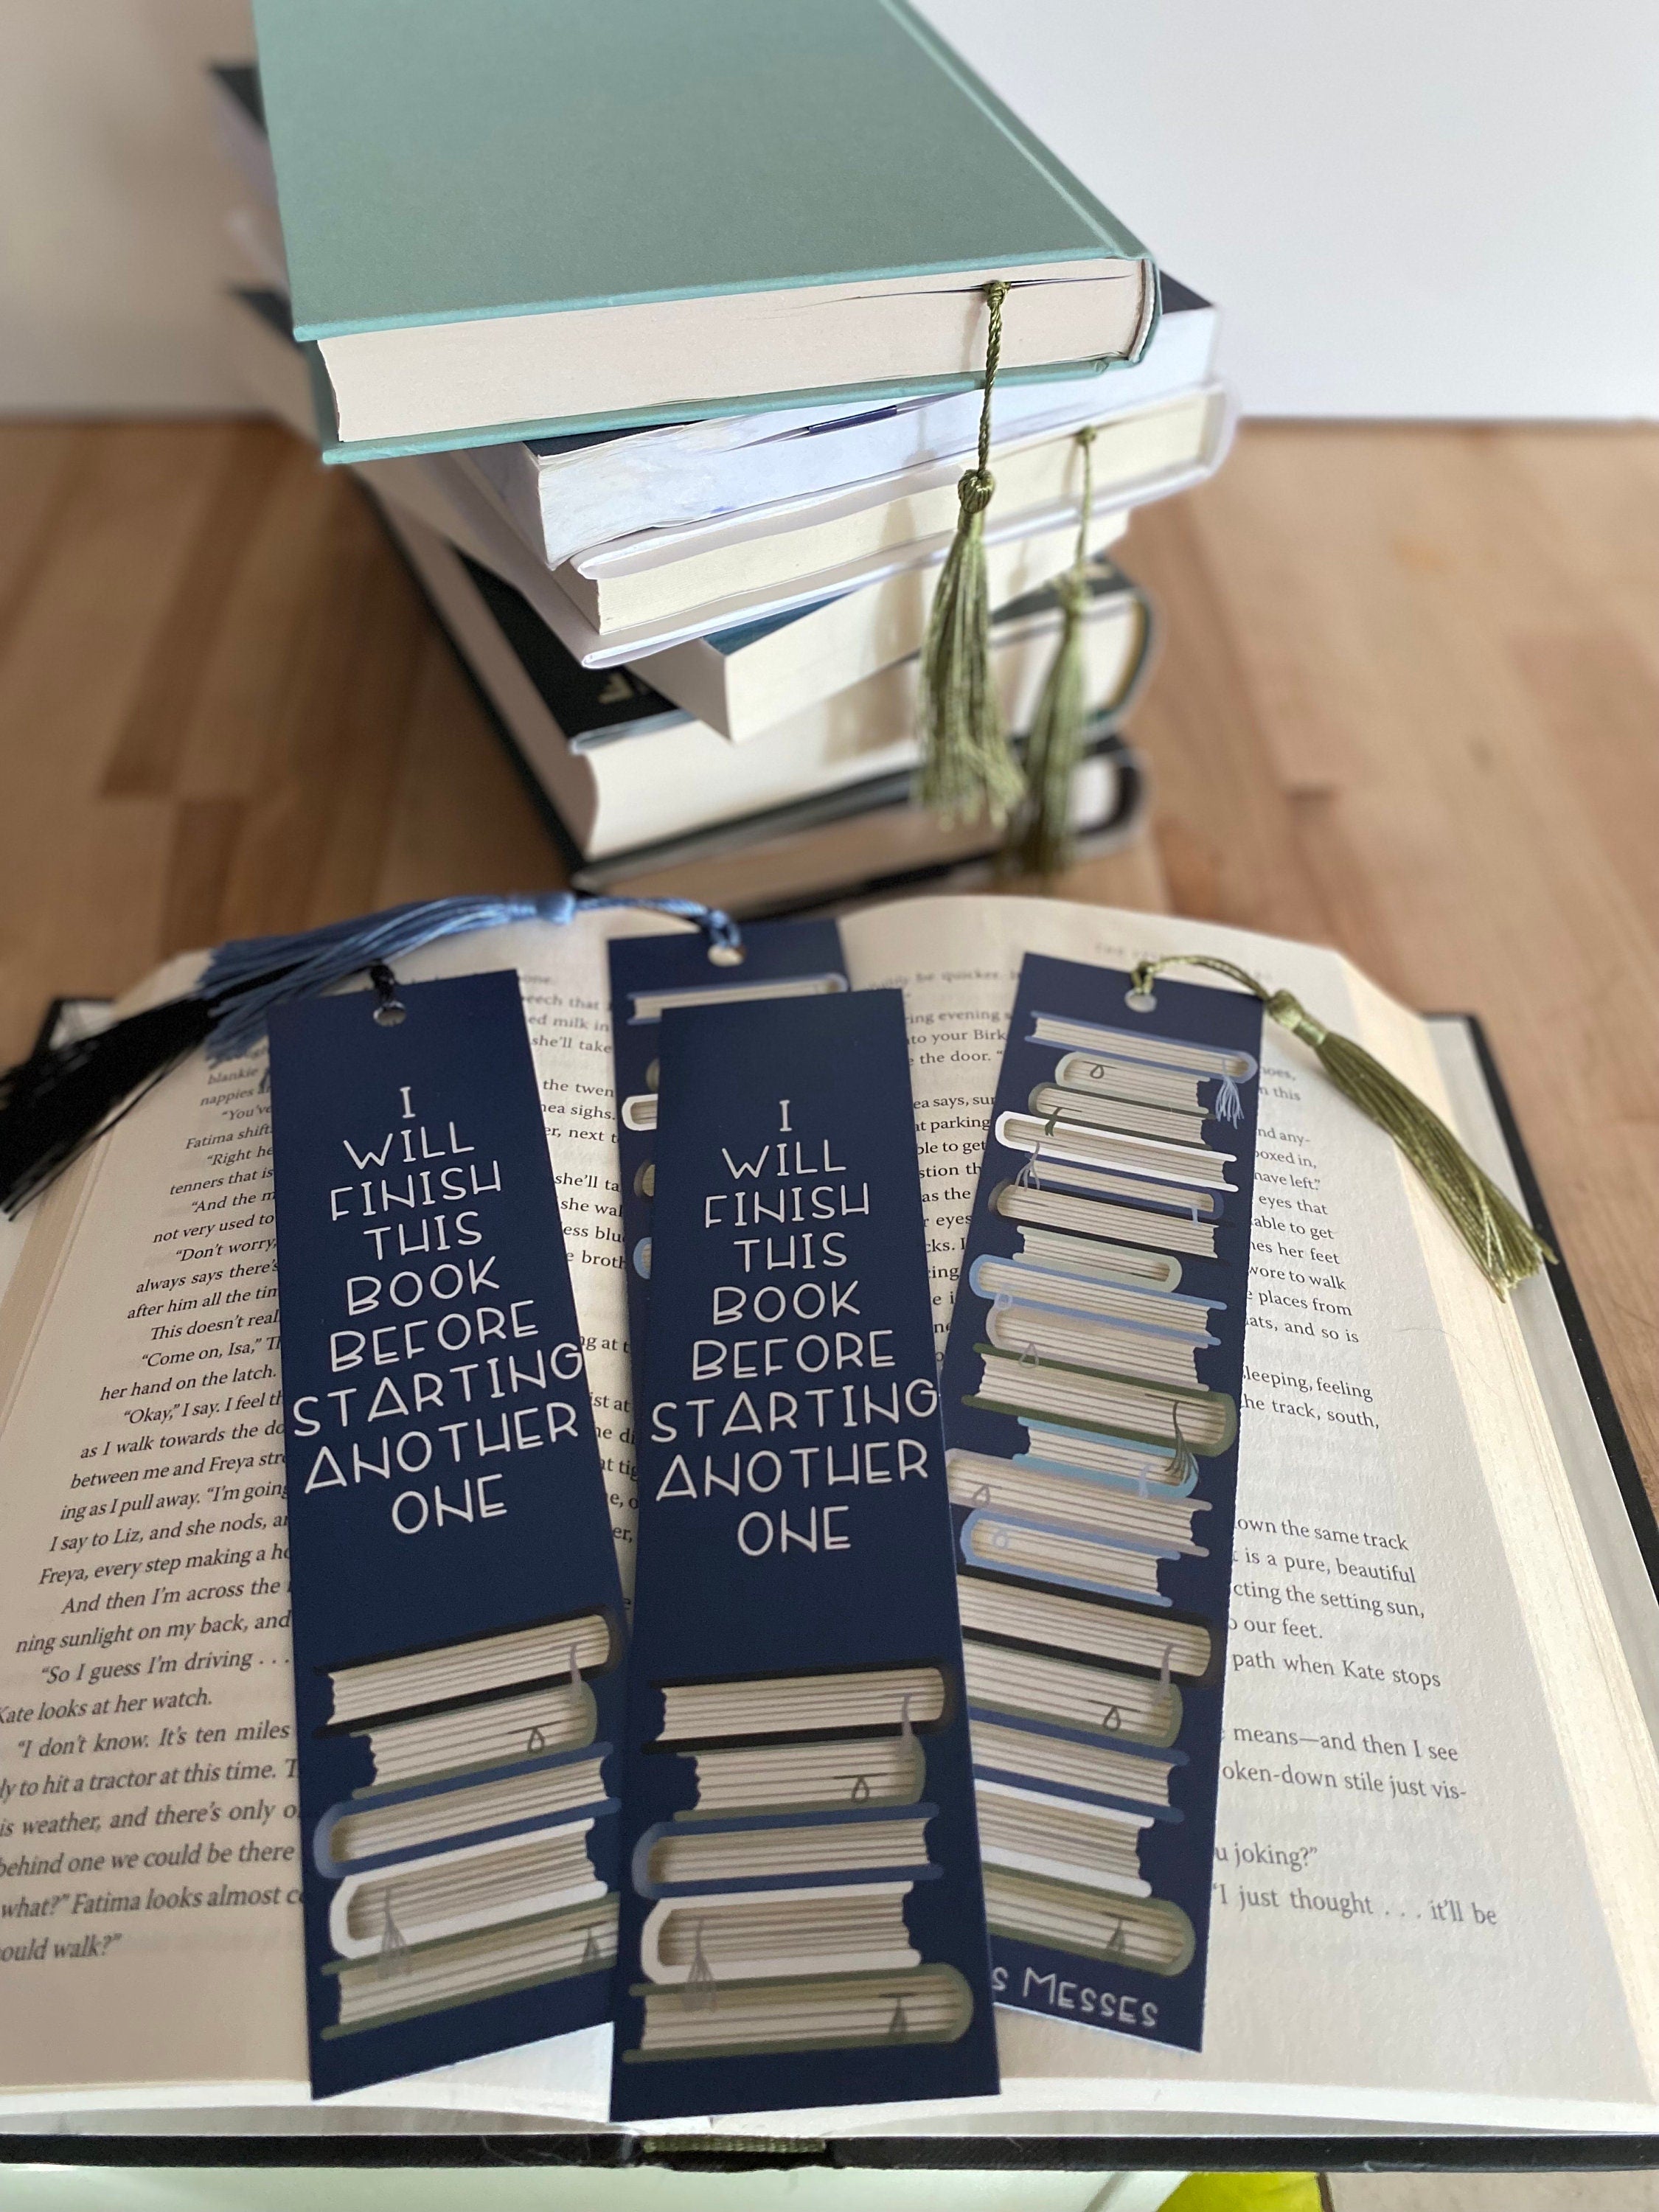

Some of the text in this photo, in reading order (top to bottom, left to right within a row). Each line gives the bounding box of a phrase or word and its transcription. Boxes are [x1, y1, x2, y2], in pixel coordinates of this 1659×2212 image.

[938, 1012, 1000, 1023] evening
[579, 1041, 611, 1053] take
[932, 1033, 967, 1045] your
[920, 1051, 990, 1064] the door.
[543, 1079, 568, 1091] the
[1273, 1087, 1301, 1101] this
[400, 1087, 415, 1118] I
[571, 1106, 616, 1120] sighs.
[779, 1100, 792, 1131] I
[933, 1097, 969, 1109] says,
[568, 1130, 604, 1141] next
[931, 1117, 990, 1133] parking
[186, 1133, 233, 1149] Fatima
[342, 1120, 475, 1171] WILL
[943, 1141, 985, 1155] to get
[1280, 1133, 1310, 1147] any-
[722, 1140, 846, 1179] WILL
[170, 1171, 258, 1194] tenners that
[329, 1158, 503, 1222] FINISH
[945, 1187, 970, 1200] the
[233, 1193, 256, 1206] the
[561, 1197, 588, 1211] she
[706, 1183, 869, 1228] FINISH
[1259, 1196, 1327, 1214] eyes that
[153, 1214, 255, 1242] not very used
[362, 1209, 484, 1262] THIS
[936, 1215, 971, 1228] eyes
[1290, 1222, 1334, 1240] to get
[734, 1233, 846, 1272] THIS
[1277, 1242, 1340, 1264] her feet
[136, 1271, 223, 1293] always says
[345, 1255, 501, 1316] BOOK
[1289, 1271, 1346, 1290] to walk
[128, 1292, 221, 1318] after all
[714, 1281, 860, 1324] BOOK
[1259, 1290, 1352, 1315] places from
[151, 1325, 182, 1340] This
[329, 1299, 540, 1373] BEFORE
[1285, 1323, 1358, 1343] and so is
[199, 1349, 222, 1359] on,
[693, 1330, 895, 1380] BEFORE
[131, 1364, 276, 1396] hand latch.
[292, 1341, 583, 1437] STARTING
[1317, 1377, 1373, 1402] feeling
[192, 1403, 219, 1418] say.
[235, 1392, 265, 1410] feel
[652, 1376, 941, 1442] STARTING
[1272, 1400, 1378, 1429] track, south,
[117, 1427, 225, 1453] walk towards
[304, 1401, 578, 1495] ANOTHER
[71, 1456, 254, 1489] between Freya
[656, 1439, 928, 1501] ANOTHER
[118, 1494, 200, 1517] pull away.
[392, 1474, 507, 1534] ONE
[113, 1513, 266, 1544] Liz, nods,
[738, 1506, 850, 1556] ONE
[1281, 1520, 1409, 1551] the same track
[39, 1548, 253, 1586] Freya, every step making
[1284, 1557, 1416, 1583] pure, beautiful
[60, 1585, 244, 1614] And then across
[1286, 1585, 1424, 1618] the setting sun,
[15, 1613, 248, 1655] ning sunlight back,
[1244, 1618, 1322, 1638] our feet.
[88, 1663, 141, 1685] guess
[184, 1651, 253, 1672] driving
[1233, 1651, 1440, 1691] path when Kate stops
[37, 1687, 212, 1720] looks watch.
[93, 1733, 148, 1752] know.
[196, 1728, 226, 1743] ten
[235, 1719, 291, 1740] miles
[1363, 1734, 1406, 1756] then
[1429, 1747, 1458, 1761] see
[42, 1761, 276, 1794] hit tractor this time.
[1344, 1772, 1466, 1799] stile just vis-
[23, 1811, 101, 1835] weather,
[228, 1799, 276, 1826] only
[68, 1840, 296, 1872] one could there
[71, 1892, 141, 1914] Fatima
[145, 1886, 203, 1910] looks
[206, 1884, 282, 1907] almost
[1239, 1885, 1279, 1911] just
[1290, 1888, 1374, 1919] thought
[1471, 1902, 1497, 1925] be
[1023, 1968, 1157, 2026] MESSES
